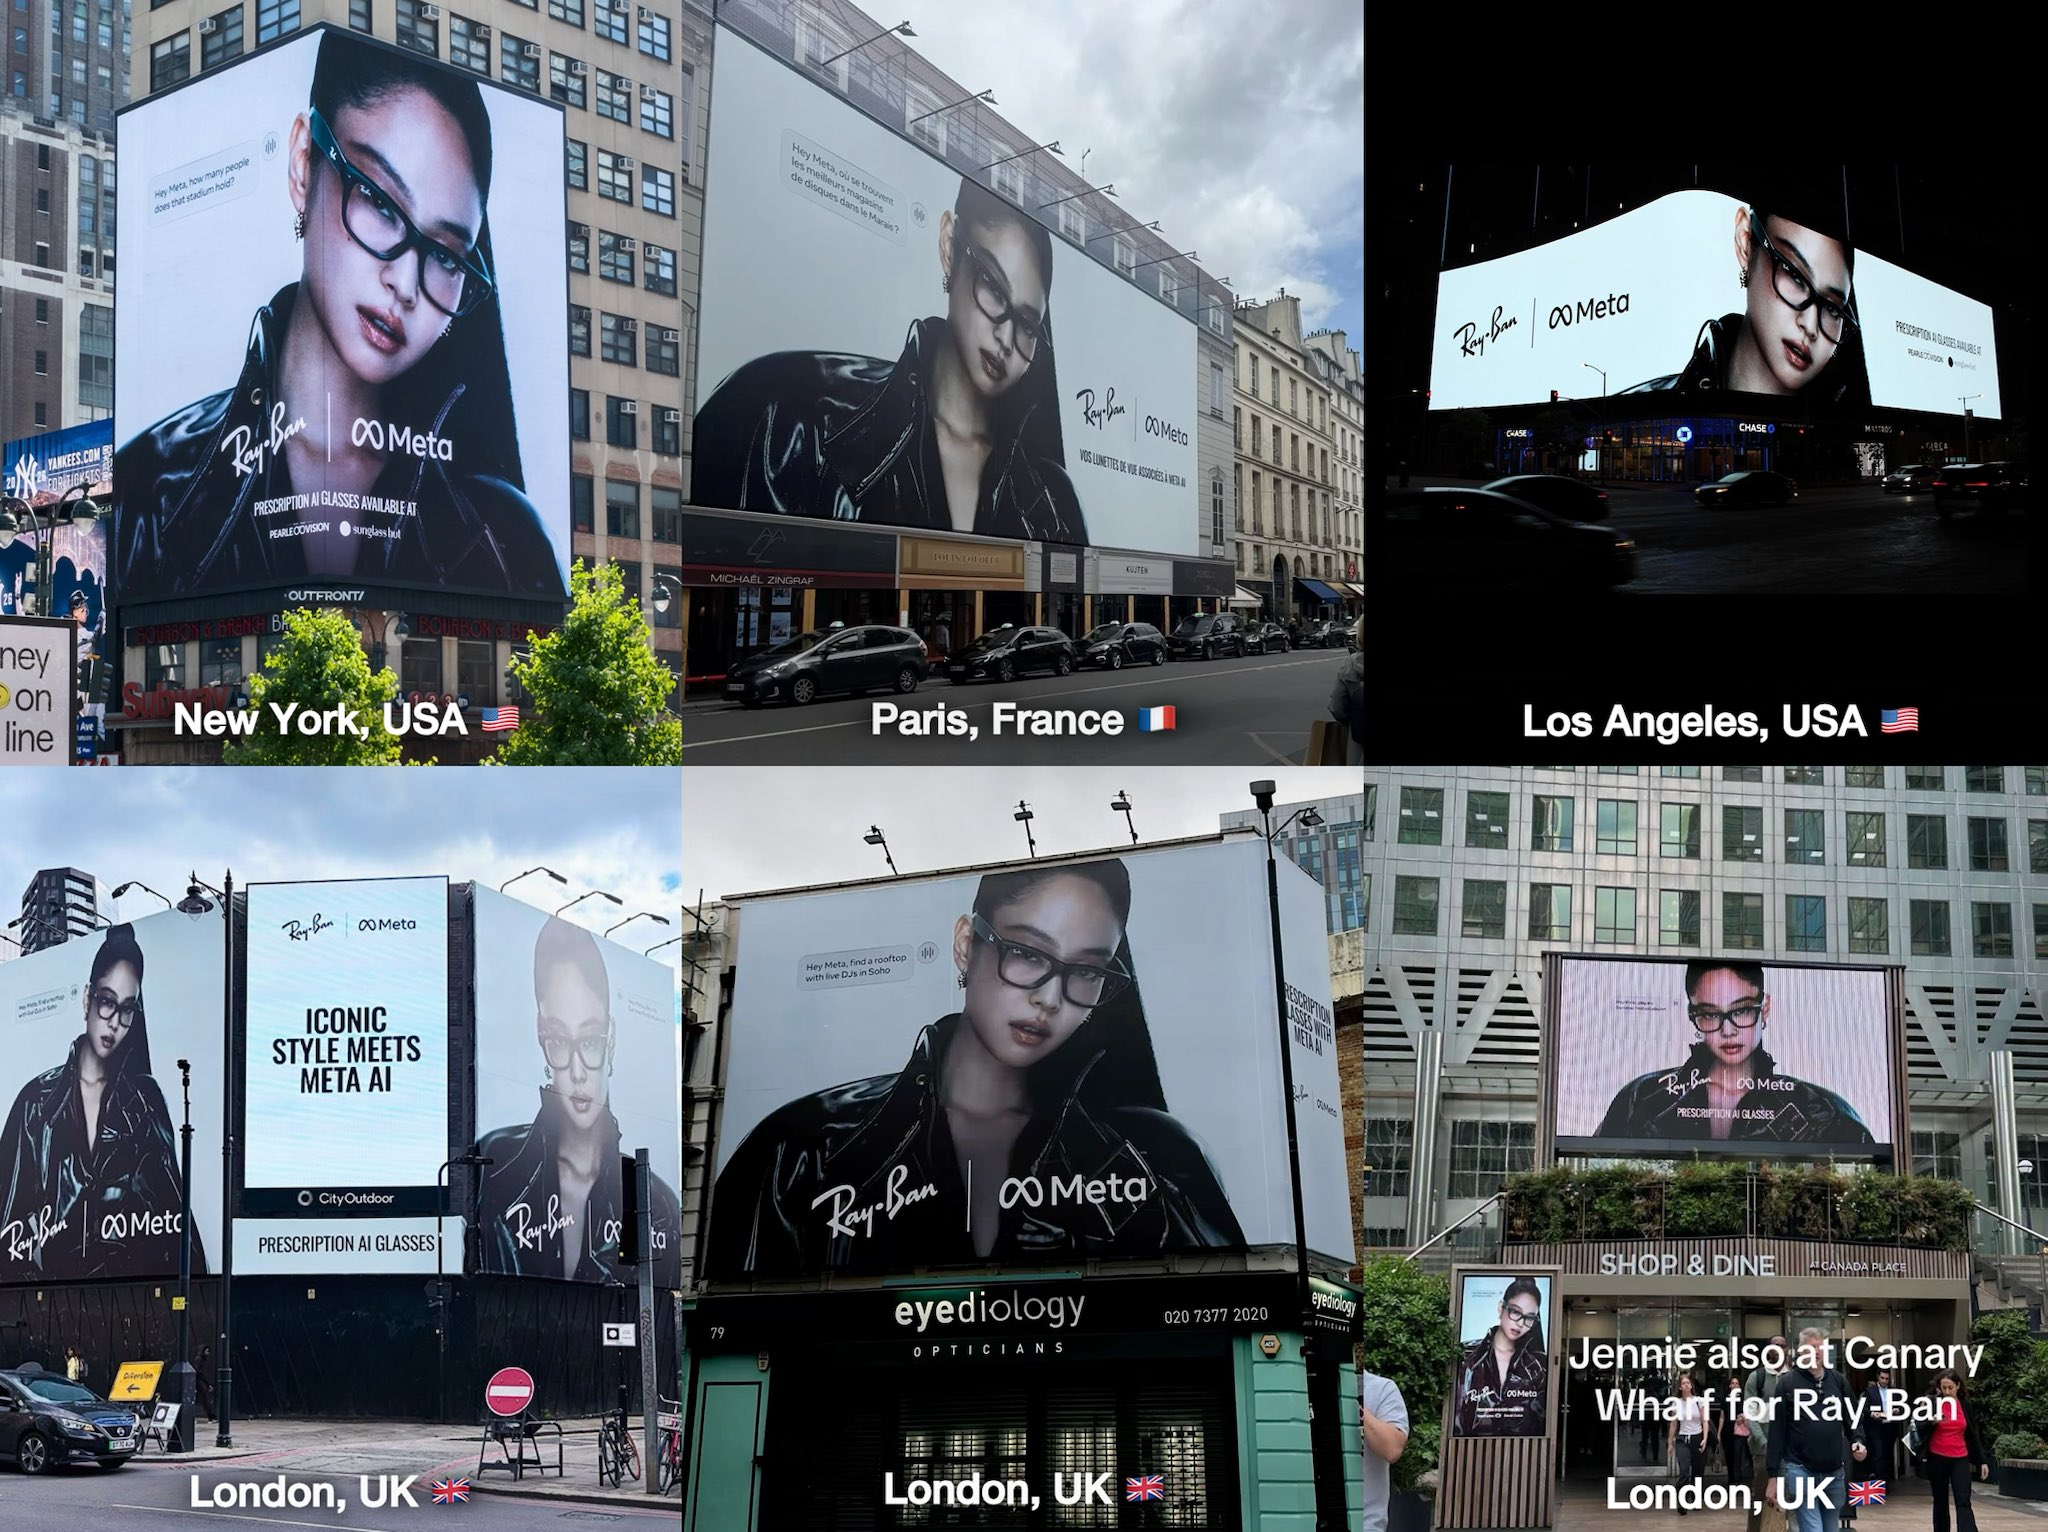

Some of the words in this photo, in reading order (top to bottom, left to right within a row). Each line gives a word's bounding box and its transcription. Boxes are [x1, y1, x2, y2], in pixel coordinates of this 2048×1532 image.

[154, 190, 168, 199] Hey
[169, 182, 188, 194] Meta,
[189, 176, 204, 186] how
[205, 168, 224, 180] many
[225, 157, 250, 175] people
[791, 157, 805, 171] les
[806, 166, 846, 193] meilleurs
[847, 188, 884, 213] magasins
[792, 142, 811, 160] Hey
[813, 153, 838, 176] Meta,
[839, 168, 850, 181] où
[851, 176, 861, 187] se
[862, 181, 895, 206] trouvent
[154, 202, 171, 214] does
[171, 196, 186, 208] that
[187, 186, 215, 203] stadium
[215, 176, 235, 192] hold?
[791, 172, 803, 185] de
[804, 178, 839, 203] disques
[840, 197, 860, 215] dans
[861, 207, 868, 218] le
[869, 211, 894, 232] Marais
[1577, 293, 1629, 324] Meta
[1896, 320, 1931, 341] PRESCRIPTION
[1937, 333, 1956, 349] GLASSES
[1957, 340, 1977, 355] AVAILABLE
[1161, 421, 1188, 446] Meta
[1739, 423, 1767, 433] CHASE
[389, 423, 453, 461] Meta
[48, 448, 100, 471] YANKEES.COM
[1080, 448, 1092, 464] VOS
[1093, 452, 1119, 471] LUNETTES
[1120, 460, 1127, 474] DE
[1128, 462, 1138, 476] VUE
[6, 476, 16, 490] 20
[36, 470, 47, 483] 26
[48, 476, 62, 490] FOR
[254, 494, 310, 517] PRESCRIPTION
[311, 495, 320, 507] AI
[321, 490, 360, 509] GLASSES
[361, 496, 406, 516] AVAILABLE
[407, 502, 418, 517] AT
[353, 525, 387, 539] sunglass
[767, 576, 815, 585] ZINGRAF
[1126, 565, 1149, 575] KUJTEN
[3, 593, 13, 606] 26
[136, 623, 199, 645] BOURBON
[217, 615, 267, 637] BRANCH
[418, 614, 491, 638] BOURBON
[15, 689, 52, 711] on
[6, 721, 54, 752] line
[379, 918, 416, 931] Meta
[805, 973, 824, 982] with
[825, 971, 840, 980] live
[841, 970, 858, 979] DJs
[859, 969, 867, 977] in
[868, 967, 891, 976] Soho
[806, 963, 823, 972] Hey
[824, 961, 849, 969] Meta,
[850, 958, 866, 967] find
[874, 954, 907, 964] rooftop
[1284, 982, 1331, 1026] RESCRIPTION
[306, 1006, 387, 1035] ICONIC
[1286, 1000, 1313, 1032] LASSES
[1314, 1019, 1332, 1044] WITH
[273, 1037, 340, 1064] STYLE
[347, 1035, 421, 1063] MEETS
[1294, 1024, 1314, 1052] META
[1315, 1040, 1323, 1057] AI
[300, 1066, 361, 1094] META
[368, 1065, 391, 1092] AI
[1758, 1078, 1795, 1091] Meta
[1677, 1107, 1731, 1119] PRESCRIPTION
[1732, 1109, 1740, 1119] AI
[1741, 1109, 1775, 1120] GLASSES
[1051, 1172, 1147, 1206] Meta
[259, 1235, 354, 1254] PRESCRIPTION
[358, 1235, 371, 1252] AI
[375, 1234, 435, 1252] GLASSES
[1600, 1253, 1678, 1276] SHOP
[1686, 1253, 1706, 1276] &
[1713, 1254, 1775, 1277] DINE
[1820, 1261, 1869, 1272] CANADA
[1871, 1262, 1907, 1273] PLACE
[895, 1290, 1085, 1332] eyediology
[1164, 1309, 1190, 1324] 020
[1193, 1308, 1228, 1323] 7377
[1233, 1307, 1268, 1322] 2020
[1312, 1291, 1357, 1318] eyediology
[710, 1326, 725, 1339] 79
[1314, 1319, 1350, 1333] OPTICIANS
[913, 1342, 1063, 1357] OPTICIANS
[123, 1371, 154, 1380] Diversion
[1517, 1390, 1538, 1398] Meta
